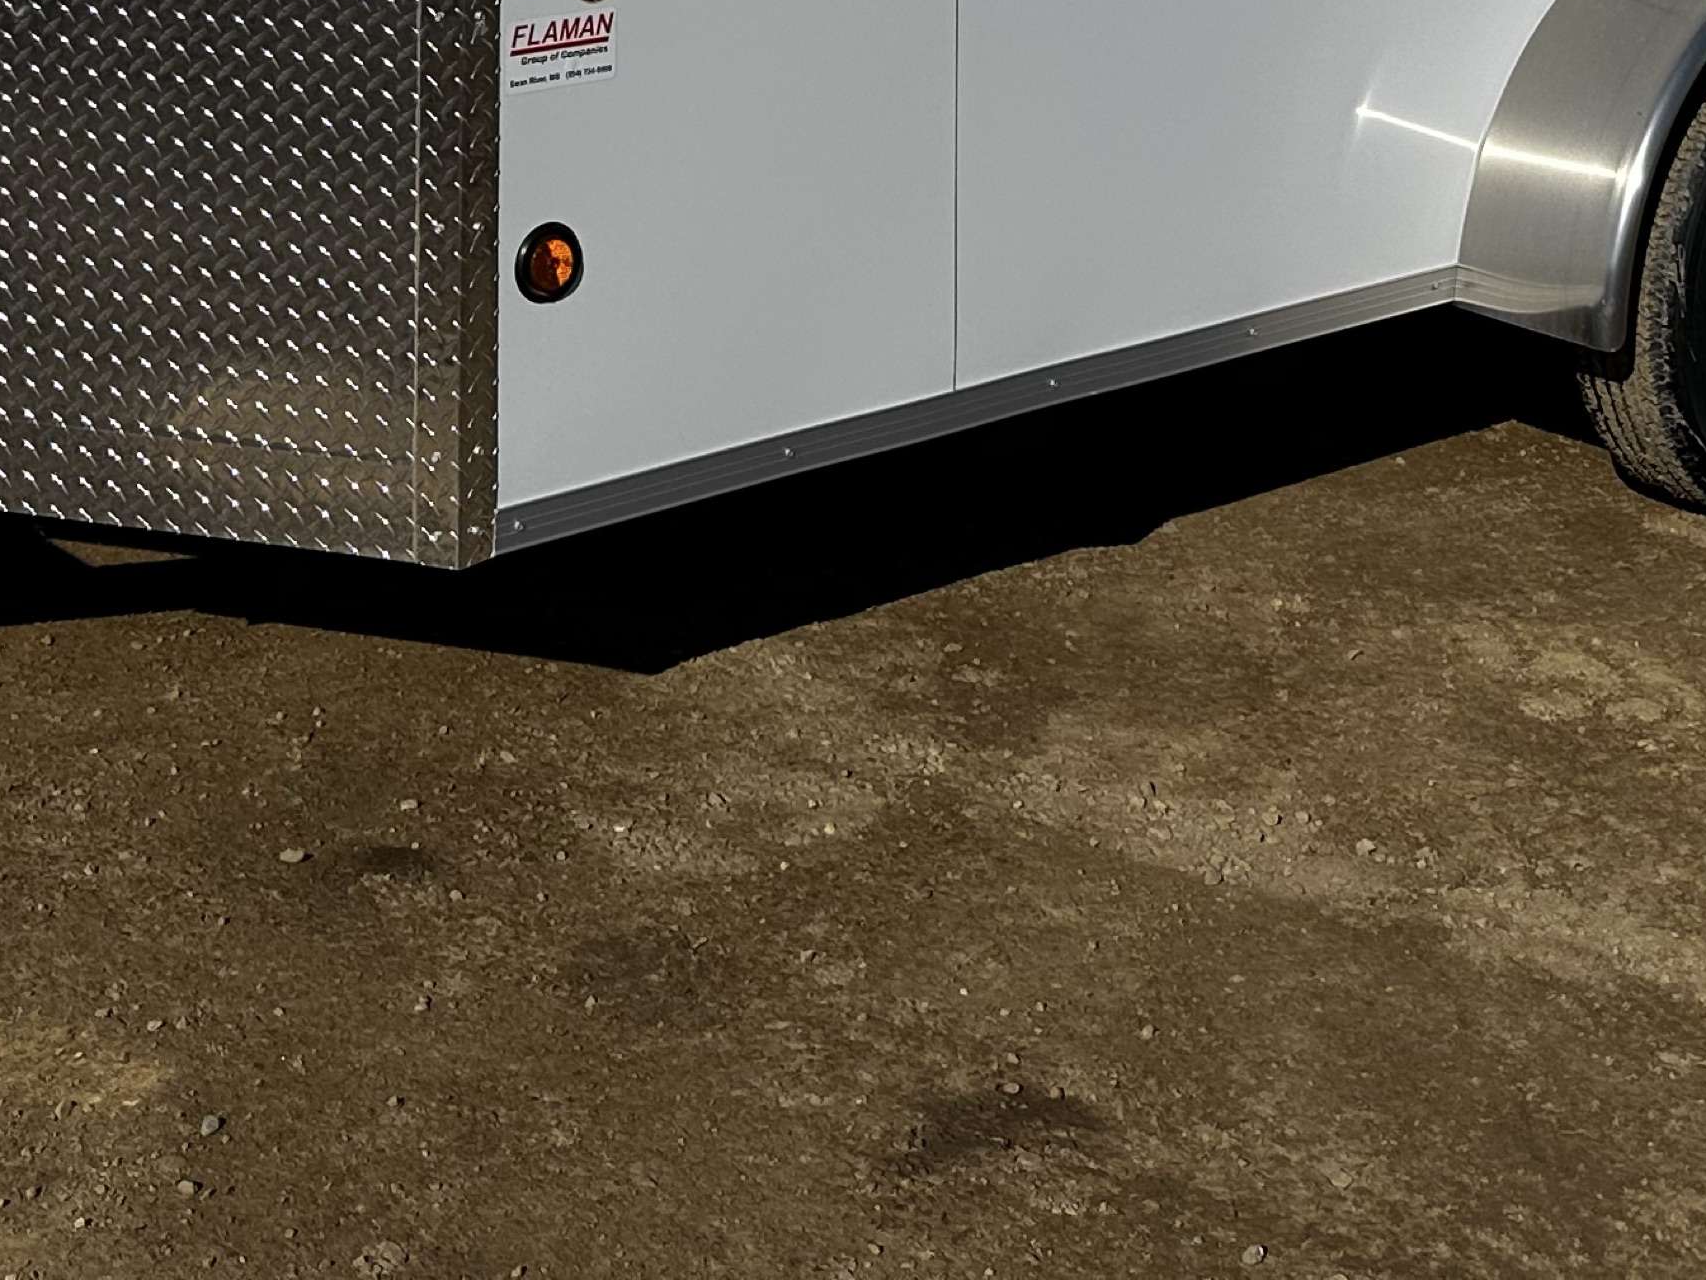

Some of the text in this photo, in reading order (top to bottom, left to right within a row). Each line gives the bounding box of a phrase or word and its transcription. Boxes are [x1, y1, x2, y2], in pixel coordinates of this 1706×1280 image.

[511, 11, 614, 48] FLAMAN
[521, 45, 608, 66] Group of Companies
